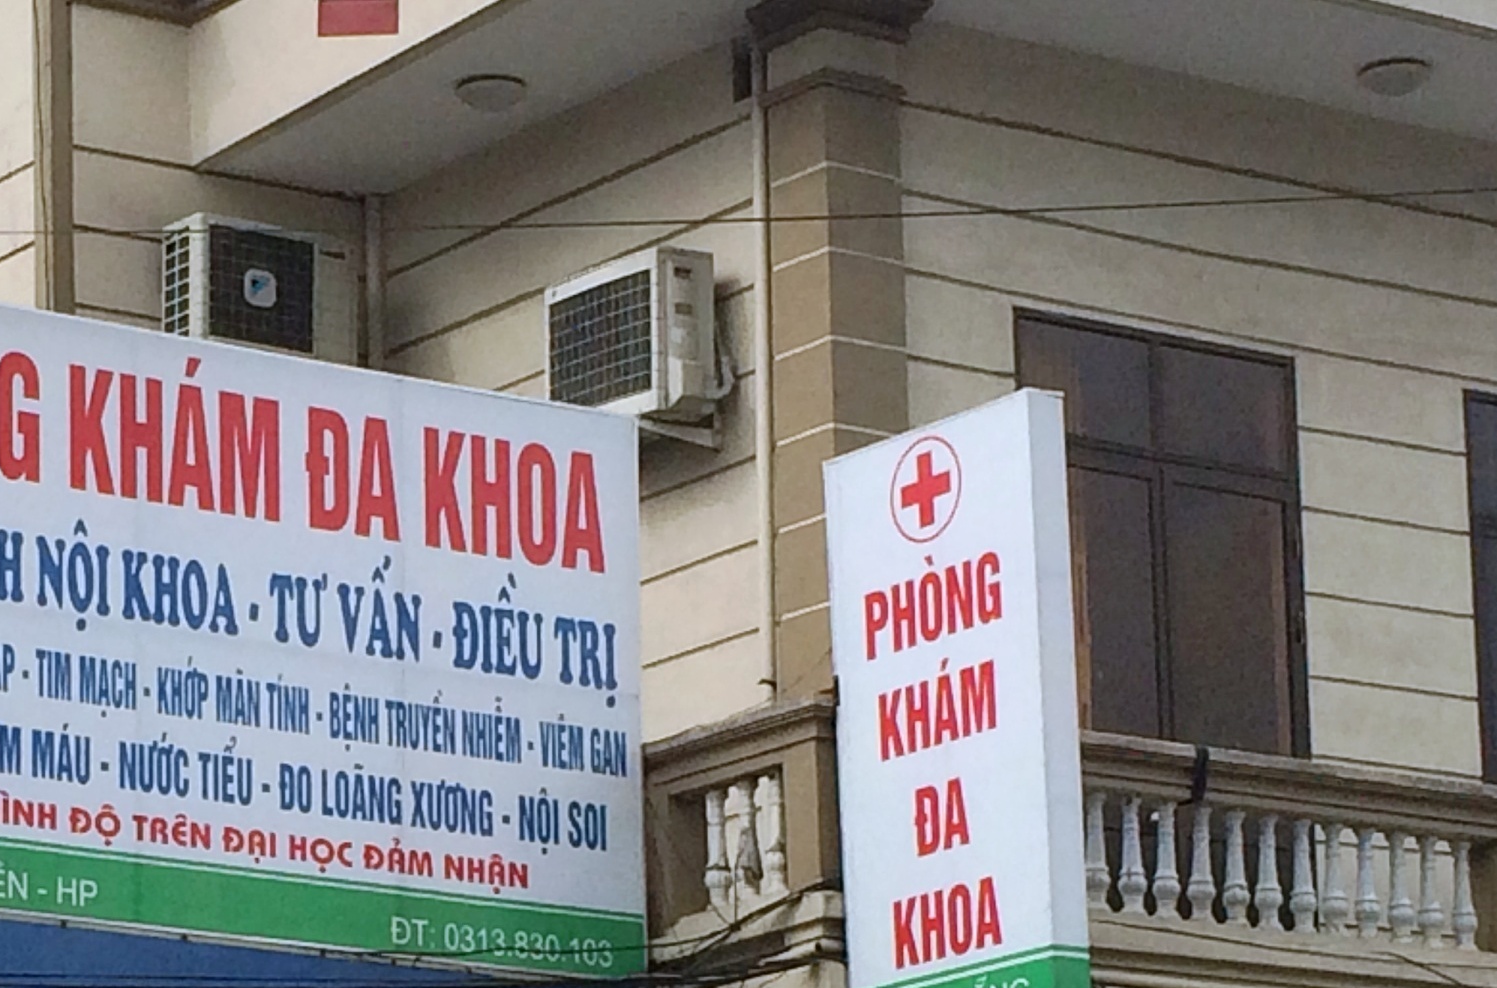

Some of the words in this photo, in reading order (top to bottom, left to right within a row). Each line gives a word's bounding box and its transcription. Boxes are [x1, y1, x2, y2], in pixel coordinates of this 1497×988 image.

[68, 357, 282, 523] KHÁM
[305, 405, 402, 543] ĐA
[423, 426, 607, 574] KHOA
[35, 518, 111, 631] NỘI
[121, 548, 239, 636] KHOA
[268, 572, 329, 648] TƯ
[337, 555, 422, 664] VẤN
[452, 572, 544, 680] ĐIỀU
[552, 614, 618, 709] TRỊ
[864, 551, 1003, 661] PHÒNG
[35, 648, 72, 702] TIM
[79, 654, 138, 718] MẠCH
[157, 655, 209, 720] KHỚP
[266, 672, 311, 736] TÍNH
[328, 681, 380, 752] BỆNH
[384, 689, 457, 756] TRUYỀN
[461, 695, 523, 765] NHIỄM
[540, 713, 586, 772] VIÊM
[590, 727, 629, 779] GAN
[877, 657, 997, 762] KHÁM
[31, 721, 92, 787] MÁU
[118, 731, 191, 799] NƯỚC
[197, 735, 254, 807] TIỂU
[278, 761, 313, 815] ĐO
[320, 761, 403, 827] LOÃNG
[409, 778, 494, 838] XƯƠNG
[518, 786, 561, 856] NỘI
[567, 799, 609, 853] SOI
[915, 776, 971, 859] ĐA
[56, 876, 99, 908] HP
[69, 803, 123, 848] ĐỘ
[132, 812, 212, 850] TRÊN
[222, 825, 278, 865] ĐẠI
[288, 834, 354, 874] HỌC
[363, 837, 434, 878] ĐẢM
[443, 852, 530, 896] NHẬN
[892, 876, 1003, 970] KHOA
